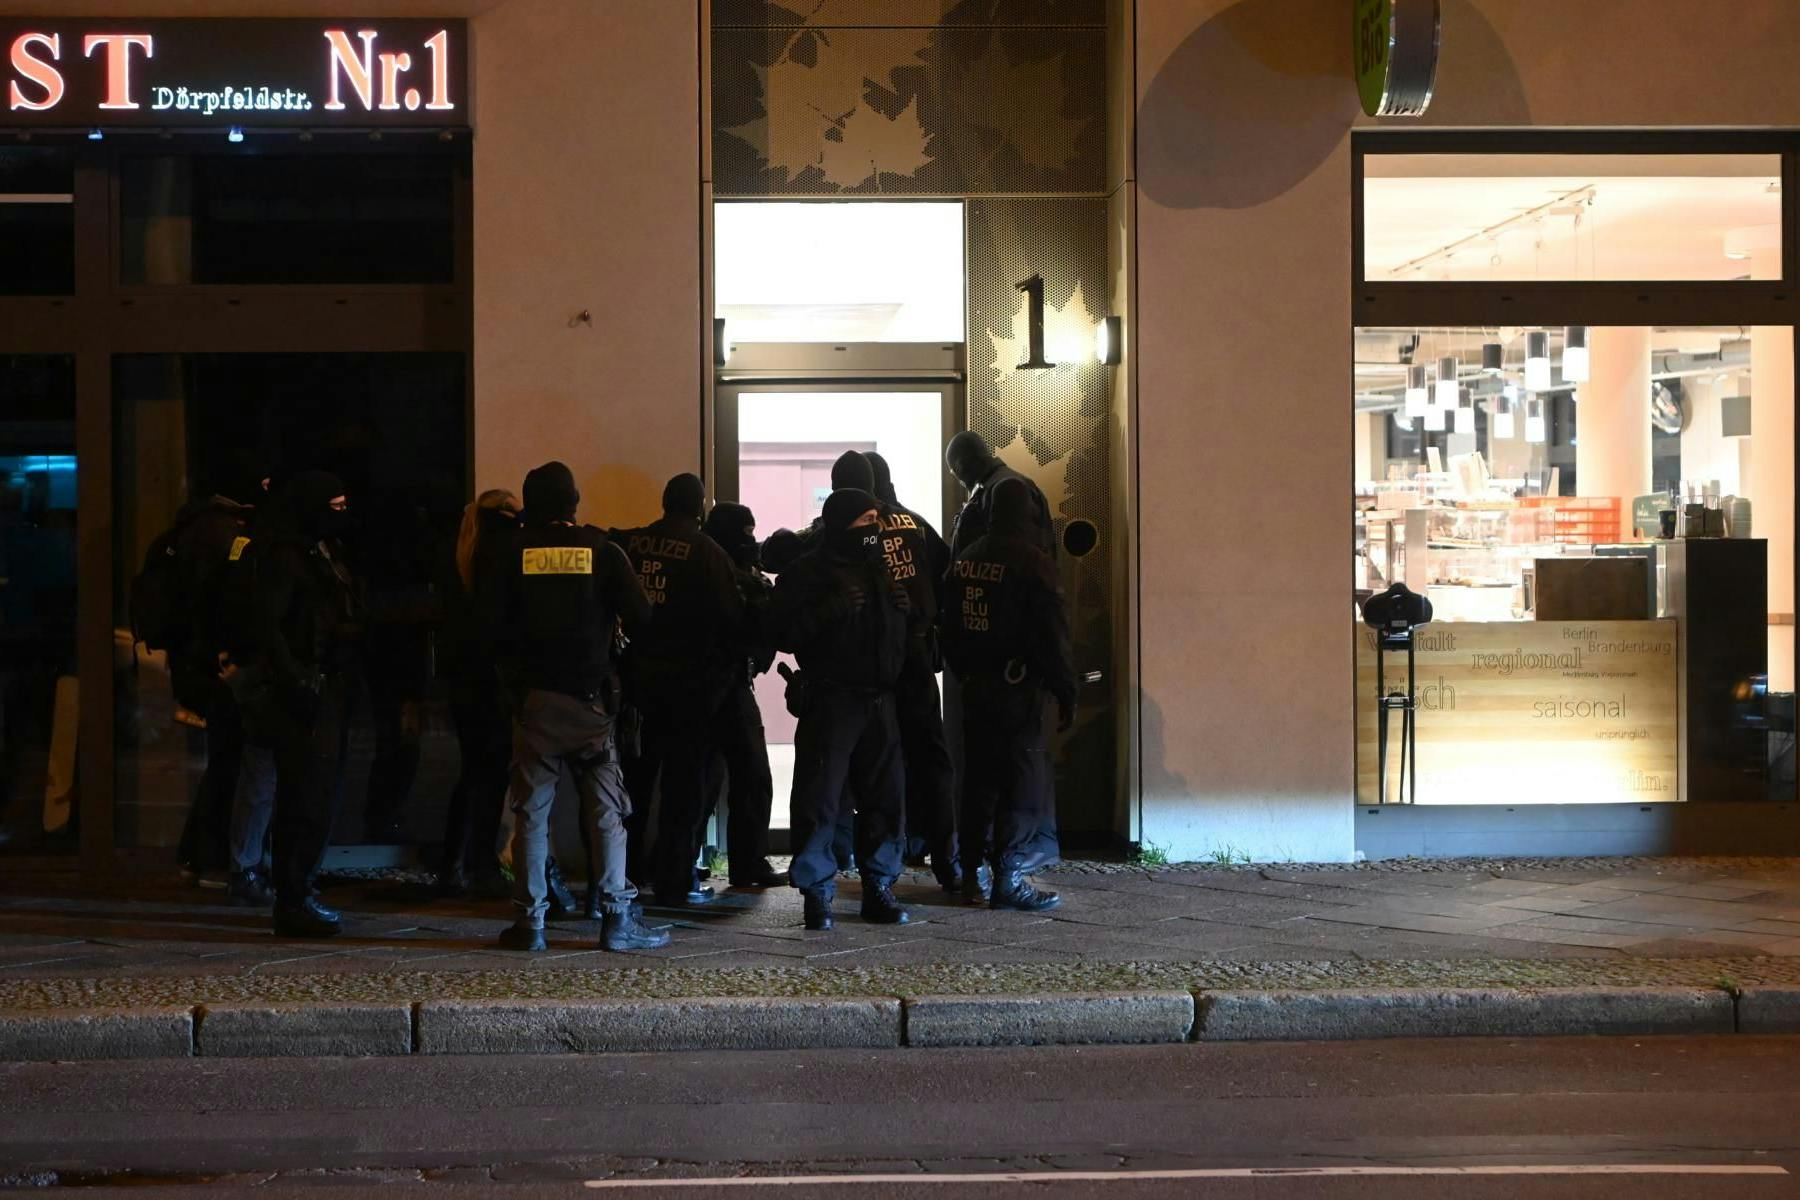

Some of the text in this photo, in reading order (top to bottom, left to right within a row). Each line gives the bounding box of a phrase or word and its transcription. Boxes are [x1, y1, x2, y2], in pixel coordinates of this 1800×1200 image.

[151, 86, 313, 115] Dörpfeldstr.
[323, 28, 455, 111] Nr.1
[1015, 273, 1056, 370] 1
[878, 513, 917, 532] LIZEI
[629, 536, 691, 560] POLIZEI
[882, 536, 903, 553] BP
[525, 550, 591, 572] POLIZEI
[642, 560, 662, 574] BP
[881, 548, 913, 567] BLU
[887, 563, 917, 581] 220
[952, 560, 1006, 583] POLIZEI
[965, 586, 984, 600] BP
[962, 600, 989, 616] BLU
[963, 615, 990, 632] 1220
[1367, 631, 1456, 652] Vfalt
[1563, 627, 1597, 640] Berlin
[1588, 640, 1671, 656] Brandenburg
[1471, 647, 1582, 675] regional
[1532, 694, 1626, 719] saisonal
